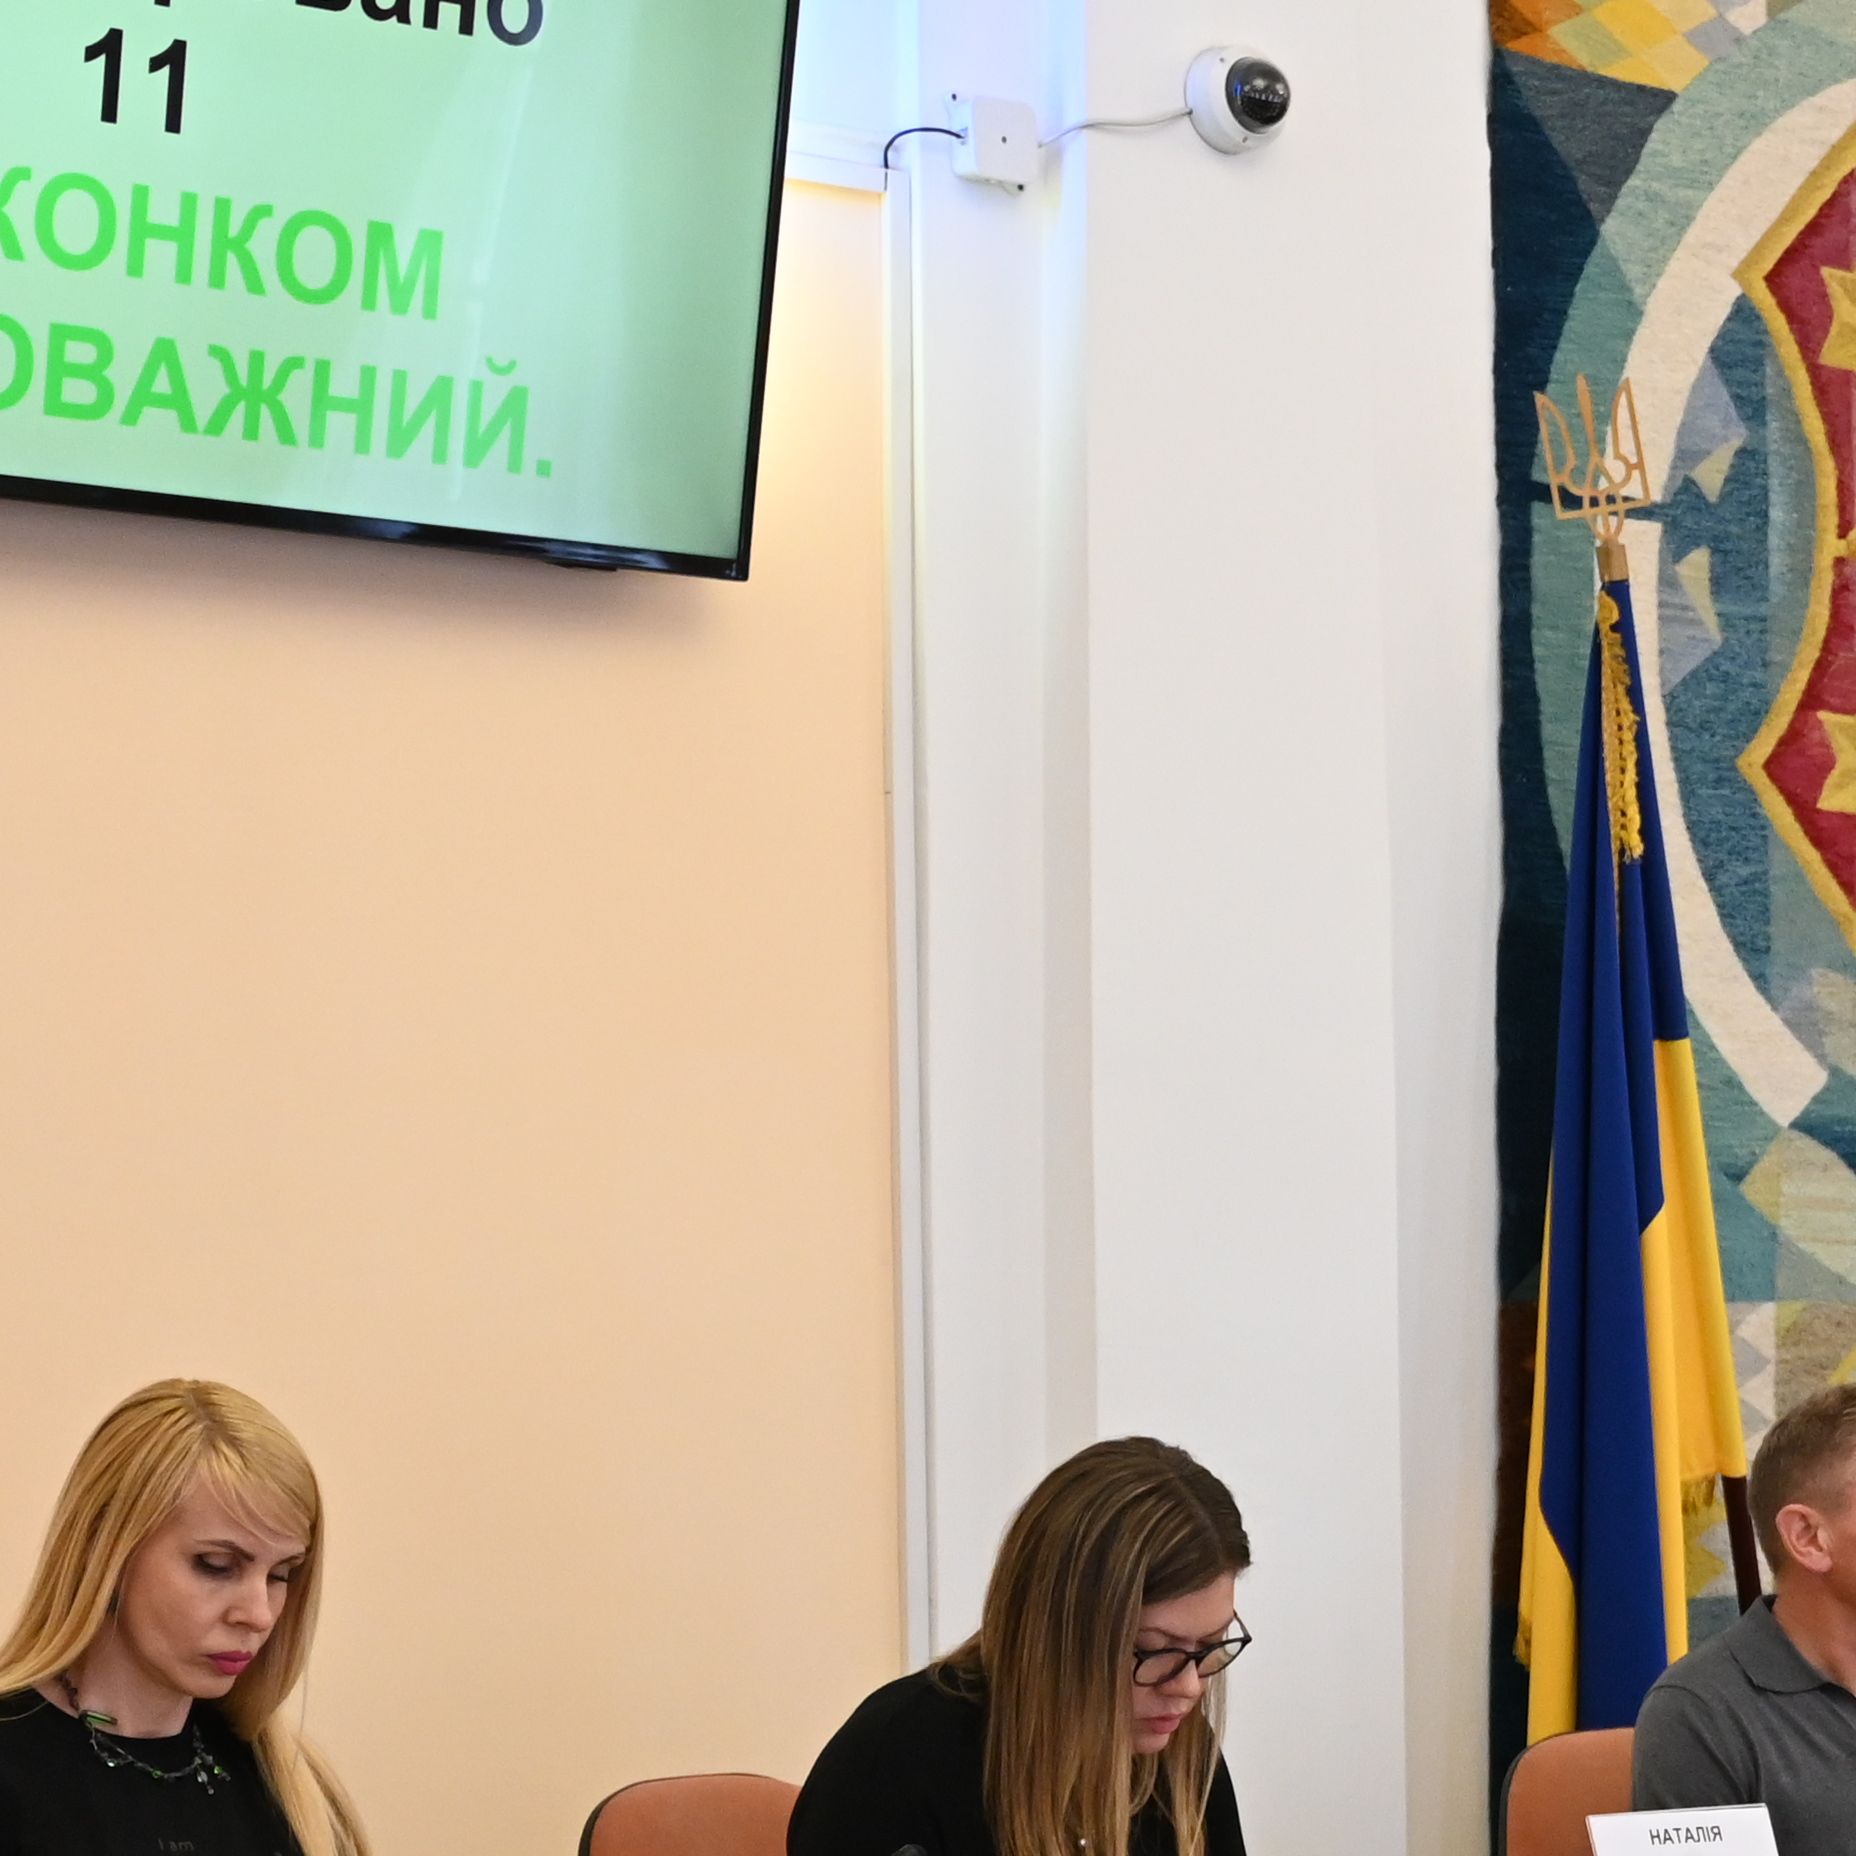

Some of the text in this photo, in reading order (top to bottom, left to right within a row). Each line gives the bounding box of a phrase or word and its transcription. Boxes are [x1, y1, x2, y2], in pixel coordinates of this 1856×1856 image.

[83, 27, 188, 134] 11
[170, 1839, 195, 1852] am
[1649, 1825, 1723, 1846] НАТАЛІЯ
